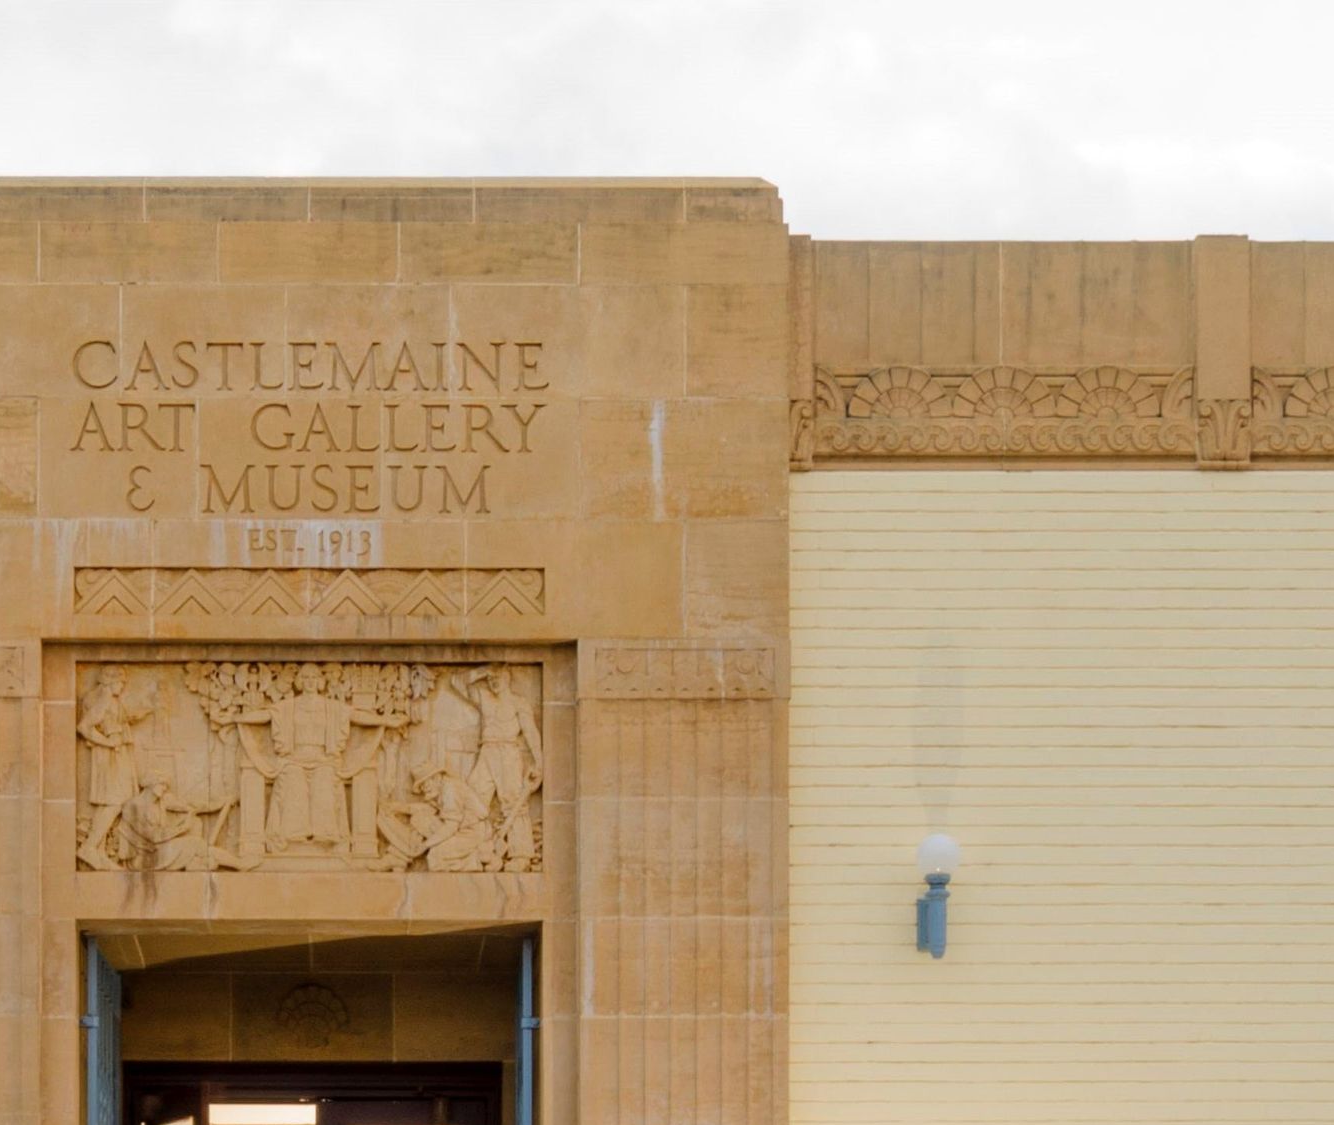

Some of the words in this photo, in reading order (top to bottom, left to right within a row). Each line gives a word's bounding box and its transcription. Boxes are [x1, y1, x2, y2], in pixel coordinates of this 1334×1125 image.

[72, 340, 550, 392] CASTLEMAINE
[70, 401, 196, 452] ART
[250, 402, 547, 454] GALLERY
[200, 464, 491, 514] MUSEUM
[247, 528, 305, 553] EST.
[317, 528, 373, 557] 1913
